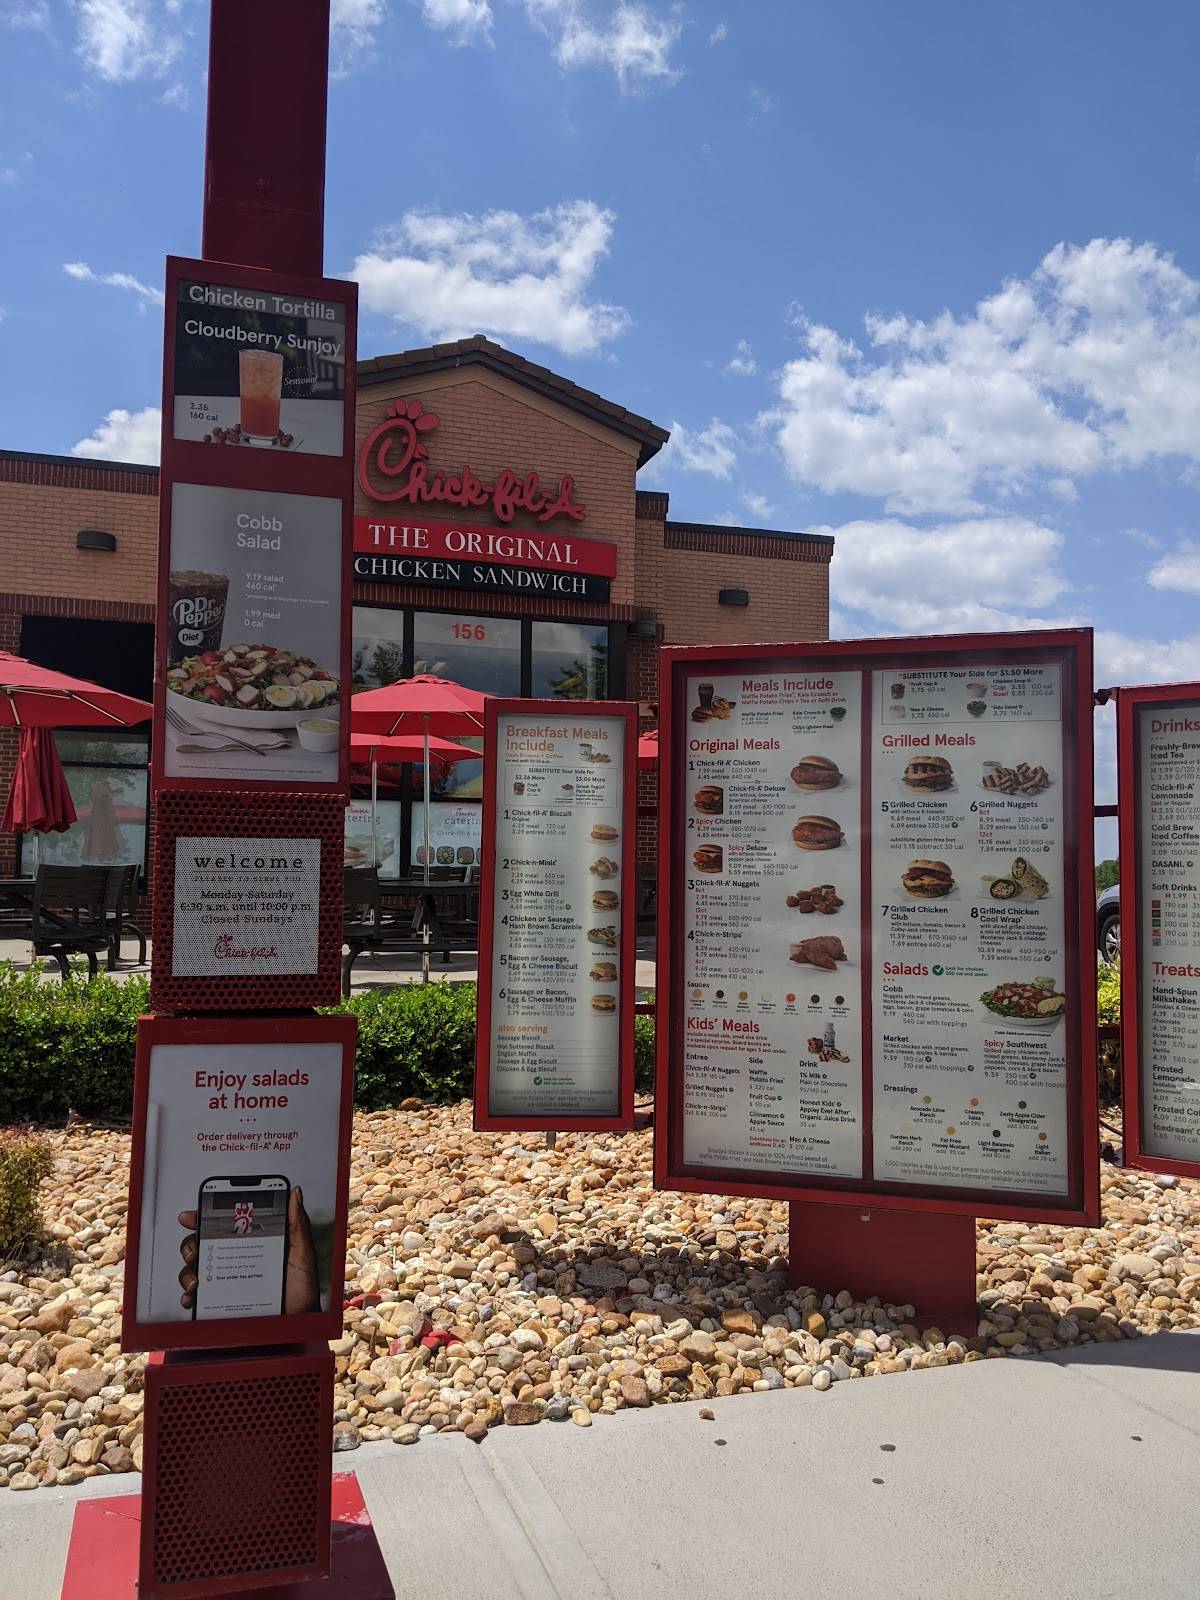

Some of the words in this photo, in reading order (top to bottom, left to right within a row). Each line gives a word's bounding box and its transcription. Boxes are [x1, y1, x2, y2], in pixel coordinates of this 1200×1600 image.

[189, 285, 266, 311] Chicken
[272, 297, 335, 320] Tortilla
[184, 319, 282, 349] Cloudberry
[287, 334, 341, 357] Sunjoy
[284, 375, 318, 385] Seasonal
[190, 403, 208, 411] 2.35
[190, 412, 204, 420] 160
[359, 400, 587, 522] Chick-fil-A
[236, 514, 282, 531] Cobb
[236, 533, 281, 550] Salad
[368, 524, 429, 549] THE
[445, 531, 579, 565] ORIGINAL
[263, 575, 283, 583] salad
[354, 557, 461, 580] CHICKEN
[473, 566, 587, 594] SANDWICH
[194, 597, 215, 611] Dr
[173, 598, 224, 627] Pepper
[245, 610, 261, 618] 1.99
[263, 611, 280, 619] med
[251, 619, 263, 627] cal
[182, 633, 199, 641] Diet
[452, 623, 485, 641] 156
[1000, 669, 1021, 677] $1.50
[742, 680, 779, 692] Meals
[784, 678, 833, 690] Include
[1151, 719, 1200, 733] Drinks
[507, 725, 568, 738] Breakfast
[572, 727, 608, 740] Meals
[506, 739, 554, 751] Include
[882, 734, 930, 747] Grilled
[935, 733, 976, 746] Meals
[690, 739, 738, 753] Original
[743, 738, 780, 750] Meals
[688, 761, 695, 770] 1
[881, 802, 889, 812] 5
[970, 802, 978, 812] 6
[504, 810, 510, 819] 1
[445, 817, 481, 825] caterin
[688, 818, 695, 828] 2
[194, 854, 303, 868] welcome
[503, 859, 509, 869] 2
[688, 880, 694, 889] 3
[732, 880, 760, 888] Nuggets
[502, 890, 508, 900] 3
[180, 902, 202, 911] 6:30
[232, 902, 257, 911] until
[261, 902, 288, 911] 10:00
[882, 906, 889, 916] 7
[971, 908, 978, 918] 8
[201, 915, 239, 924] Closed
[244, 915, 293, 925] Sundays
[501, 915, 508, 925] 4
[688, 931, 694, 940] 4
[500, 955, 507, 965] 5
[883, 962, 929, 976] Salads
[1152, 961, 1200, 977] Treats
[499, 988, 506, 998] 6
[1152, 987, 1197, 996] Hand-Spun
[1152, 995, 1196, 1004] Milkshakes
[722, 1020, 760, 1032] Meals
[984, 1040, 1004, 1048] Spicy
[1007, 1041, 1047, 1049] Southwest
[1153, 1064, 1183, 1074] Frosted
[194, 1070, 247, 1091] Enjoy
[252, 1069, 310, 1087] salads
[1153, 1073, 1195, 1083] Lemonade
[883, 1085, 918, 1094] Dressings
[208, 1095, 228, 1110] at
[233, 1093, 289, 1109] home
[1153, 1105, 1184, 1114] Frosted
[197, 1132, 225, 1141] Order
[226, 1132, 262, 1142] delivery
[264, 1130, 299, 1140] through
[202, 1143, 217, 1152] the
[273, 1142, 291, 1152] App
